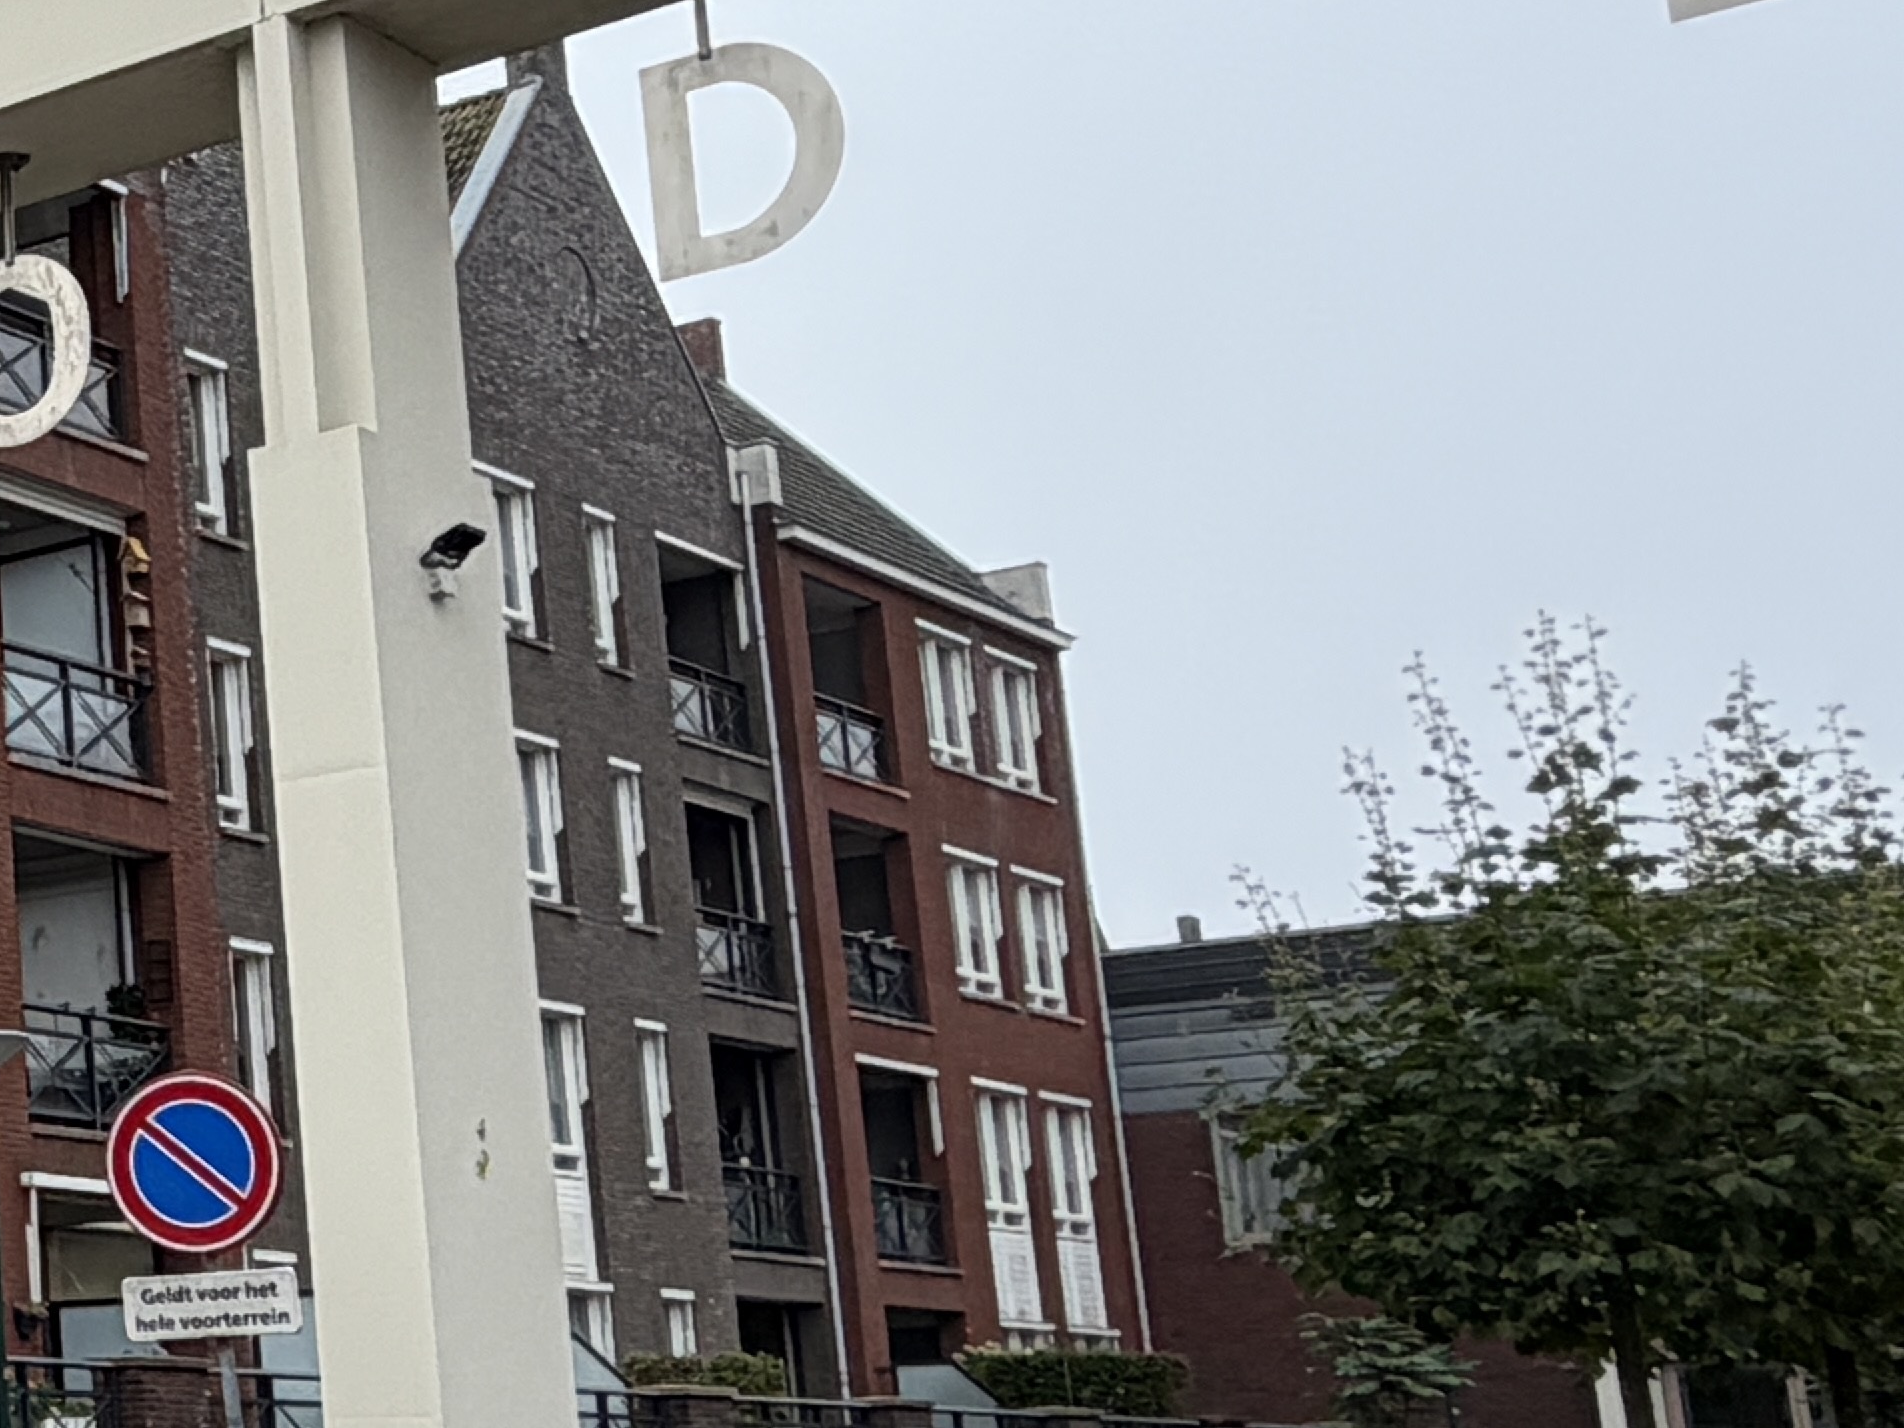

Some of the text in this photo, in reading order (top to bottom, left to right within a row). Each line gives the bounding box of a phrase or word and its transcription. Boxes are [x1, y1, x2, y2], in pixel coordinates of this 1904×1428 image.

[140, 1280, 279, 1306] Geldt voor het
[134, 1306, 291, 1332] hele voorterrein
